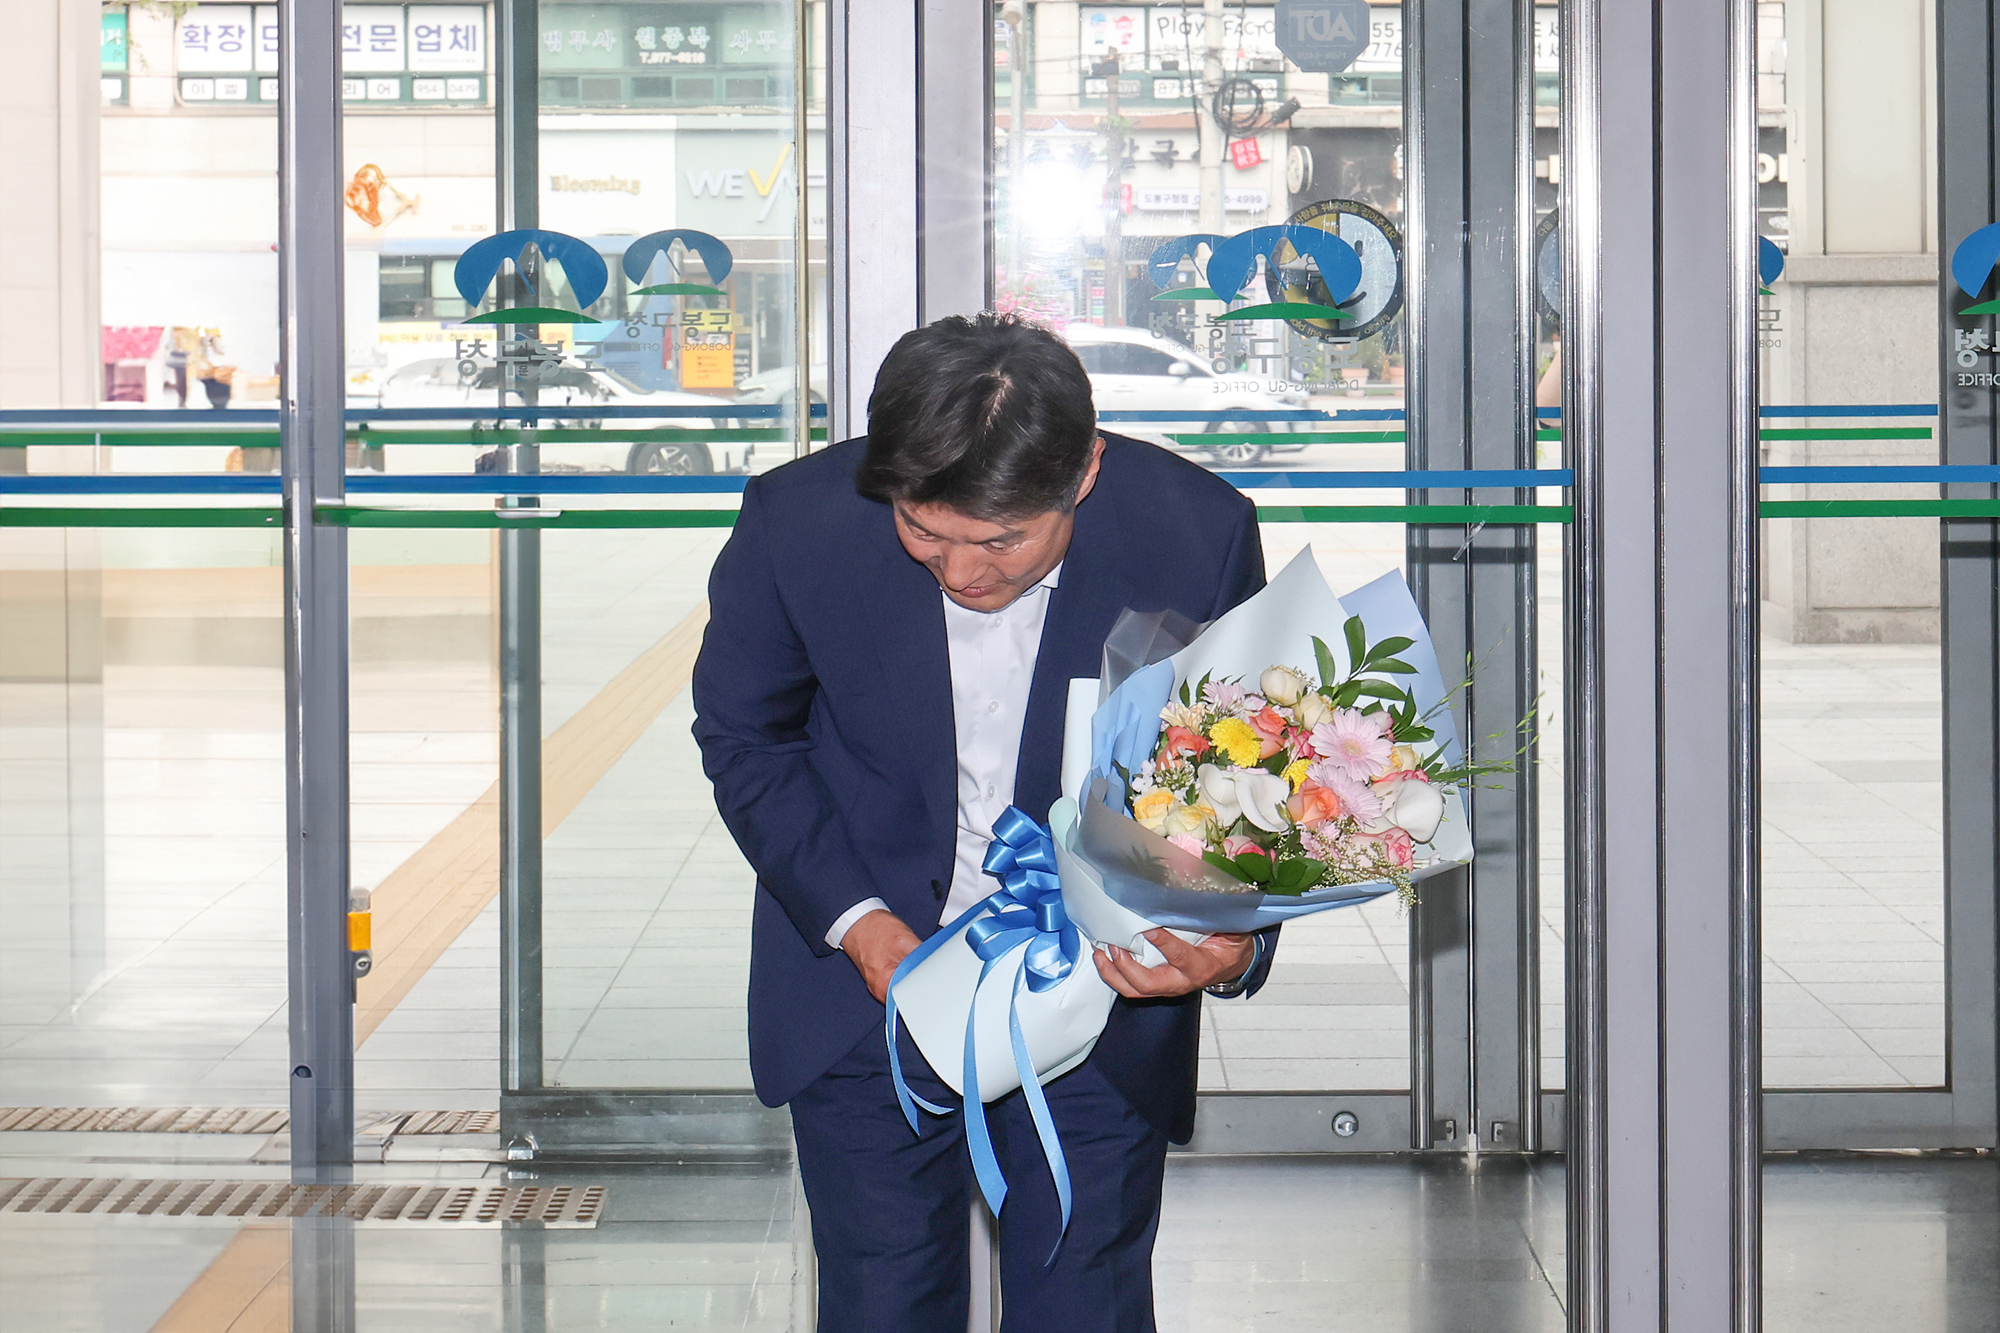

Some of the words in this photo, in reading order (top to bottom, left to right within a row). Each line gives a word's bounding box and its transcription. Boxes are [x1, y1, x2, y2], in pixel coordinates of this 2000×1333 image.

[182, 24, 246, 52] 확장
[414, 24, 477, 52] 업체
[1157, 17, 1206, 38] Play
[1223, 19, 1275, 37] FACTO
[550, 175, 641, 195] Blooming
[686, 168, 745, 198] WE
